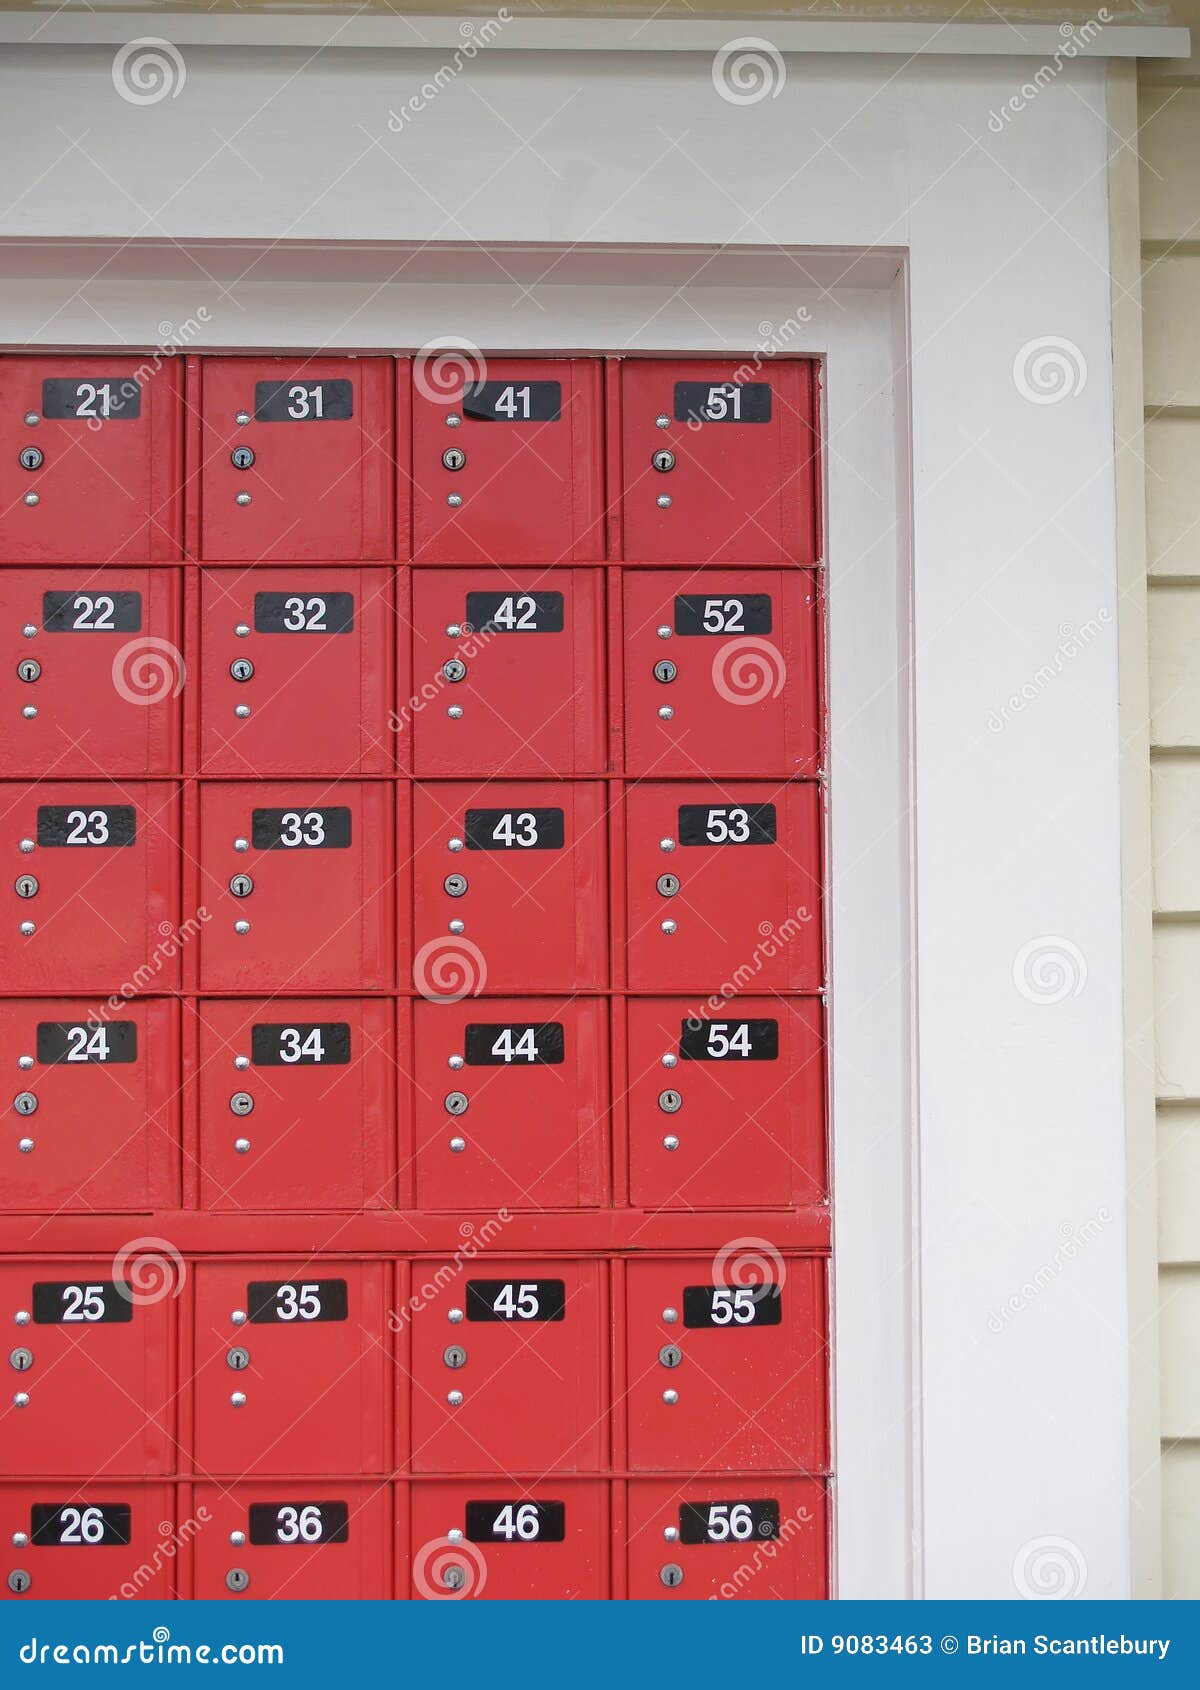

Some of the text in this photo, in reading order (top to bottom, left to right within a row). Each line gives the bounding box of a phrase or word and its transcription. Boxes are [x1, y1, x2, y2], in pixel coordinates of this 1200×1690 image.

[76, 383, 111, 416] 21
[287, 386, 323, 418] 31
[495, 387, 531, 418] 41
[706, 388, 741, 420] 51
[73, 596, 115, 629] 22
[284, 598, 326, 630] 32
[494, 597, 537, 630] 42
[703, 600, 745, 632] 52
[67, 811, 109, 845] 23
[281, 813, 324, 846] 33
[493, 813, 538, 847] 43
[706, 809, 750, 843] 53
[67, 1027, 110, 1061] 24
[280, 1029, 325, 1062] 34
[491, 1029, 538, 1062] 44
[706, 1024, 752, 1058] 54
[62, 1286, 105, 1321] 25
[276, 1285, 321, 1320] 35
[493, 1285, 538, 1319] 45
[711, 1290, 756, 1325] 55
[60, 1507, 104, 1543] 26
[277, 1506, 322, 1541] 36
[493, 1505, 540, 1540] 46
[707, 1504, 753, 1540] 56
